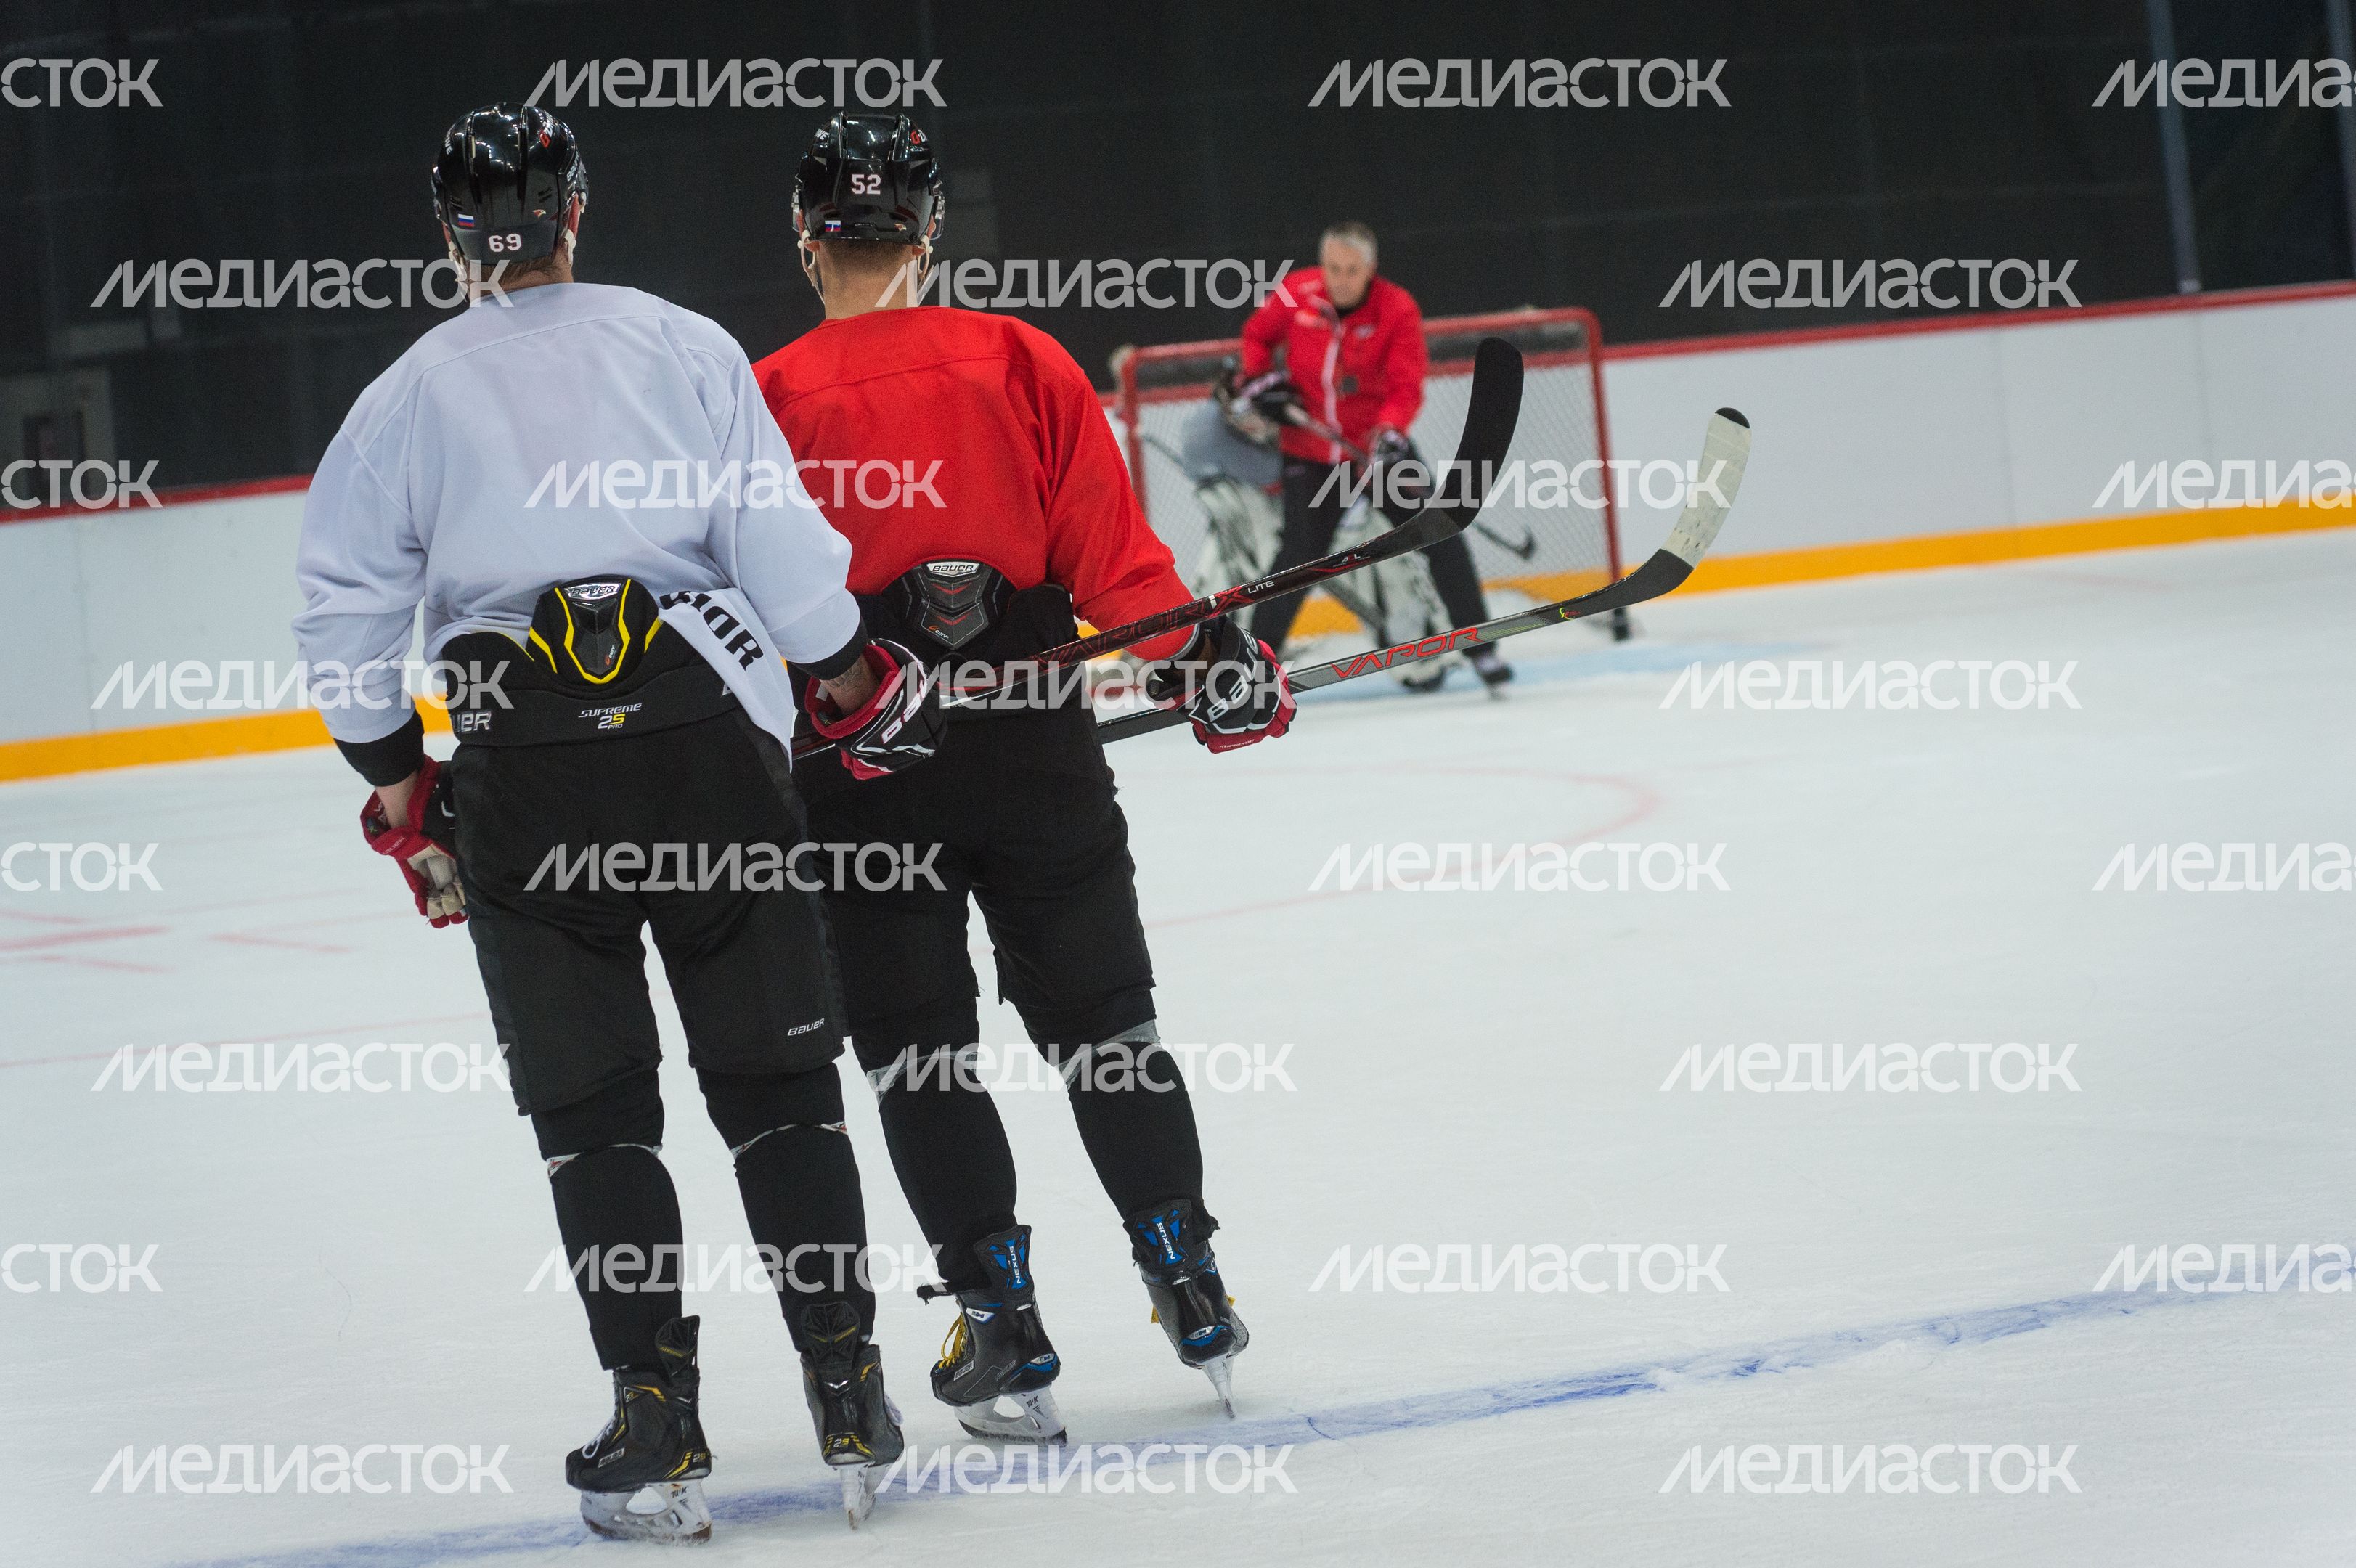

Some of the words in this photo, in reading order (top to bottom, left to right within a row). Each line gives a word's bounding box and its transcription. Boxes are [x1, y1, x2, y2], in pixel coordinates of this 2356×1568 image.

[852, 174, 881, 195] 52
[489, 233, 522, 253] 69
[1247, 580, 1275, 595] LITE
[1331, 626, 1483, 679] VAPOR
[578, 702, 643, 718] SUPREME
[787, 1018, 825, 1036] BAUER
[1157, 1222, 1175, 1260] NEXUS
[1009, 1246, 1022, 1284] NEXUS
